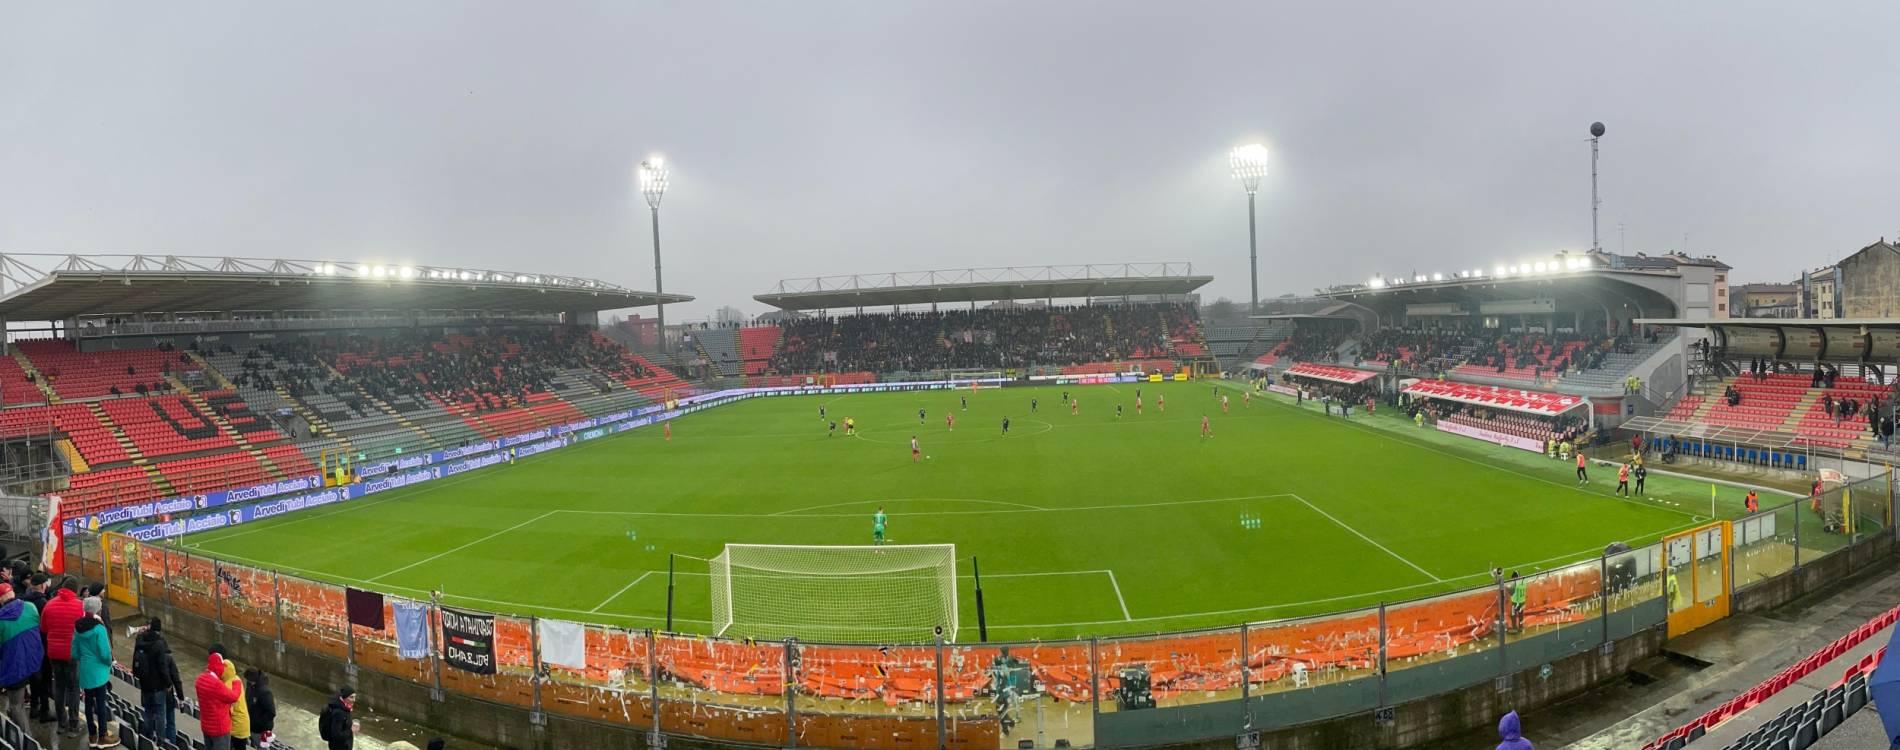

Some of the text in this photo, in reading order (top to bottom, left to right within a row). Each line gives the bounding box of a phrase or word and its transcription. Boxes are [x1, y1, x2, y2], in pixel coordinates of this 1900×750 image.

[361, 462, 386, 478] Arvedi
[227, 478, 309, 503] Arvedi Tubi Acciaio
[365, 477, 392, 494] Arvedi
[100, 499, 193, 525] Arvedi Tubi Acciaio
[254, 491, 337, 519] Arvedi Tubi Acciaio
[188, 514, 226, 531] Acciaio
